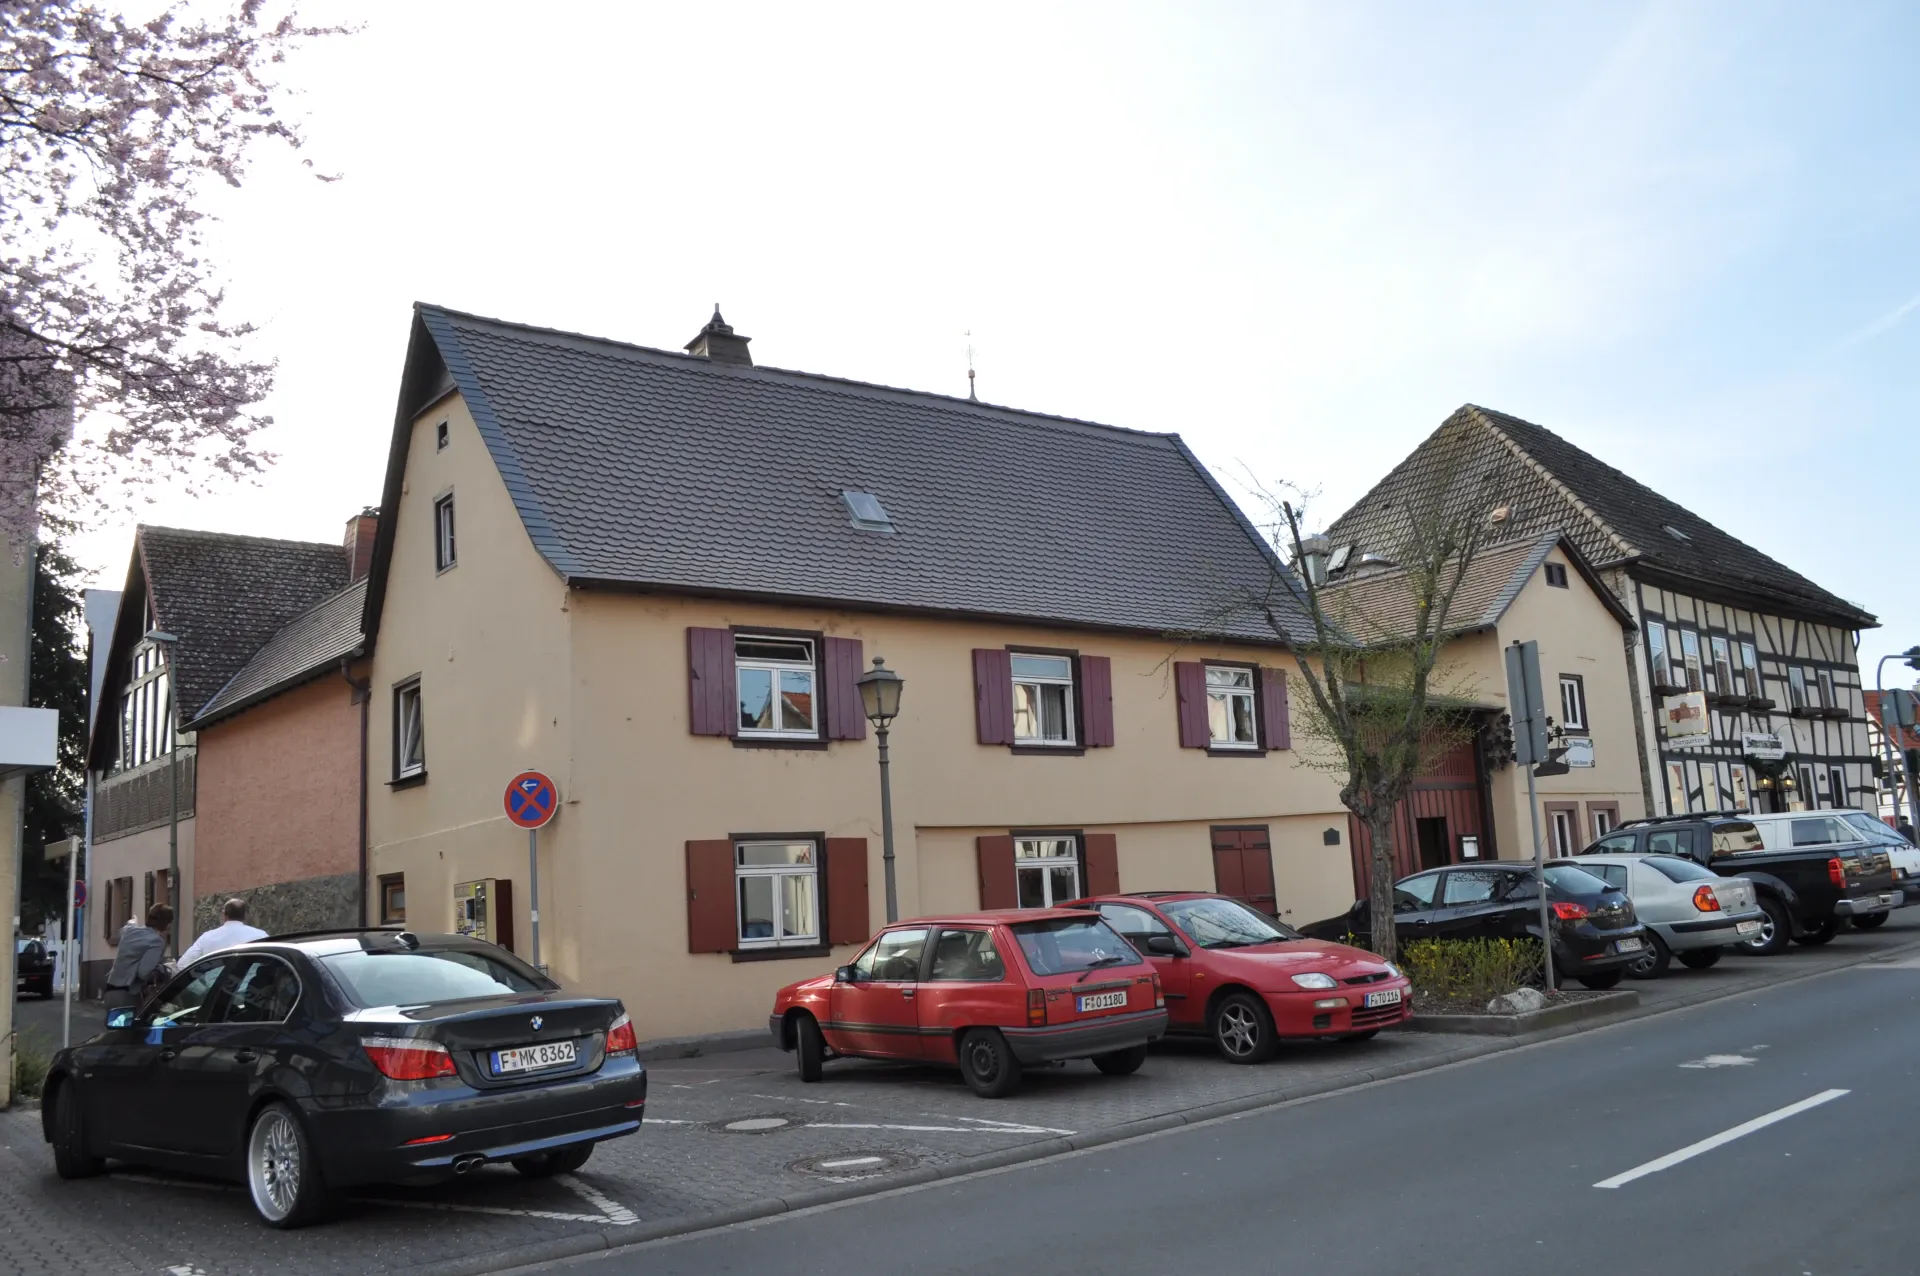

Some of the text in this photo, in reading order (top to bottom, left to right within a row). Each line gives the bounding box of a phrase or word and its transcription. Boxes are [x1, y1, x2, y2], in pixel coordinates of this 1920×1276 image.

[1103, 993, 1124, 1006] 1180
[500, 1053, 509, 1070] F
[519, 1048, 538, 1067] MK
[540, 1043, 574, 1063] 8362
